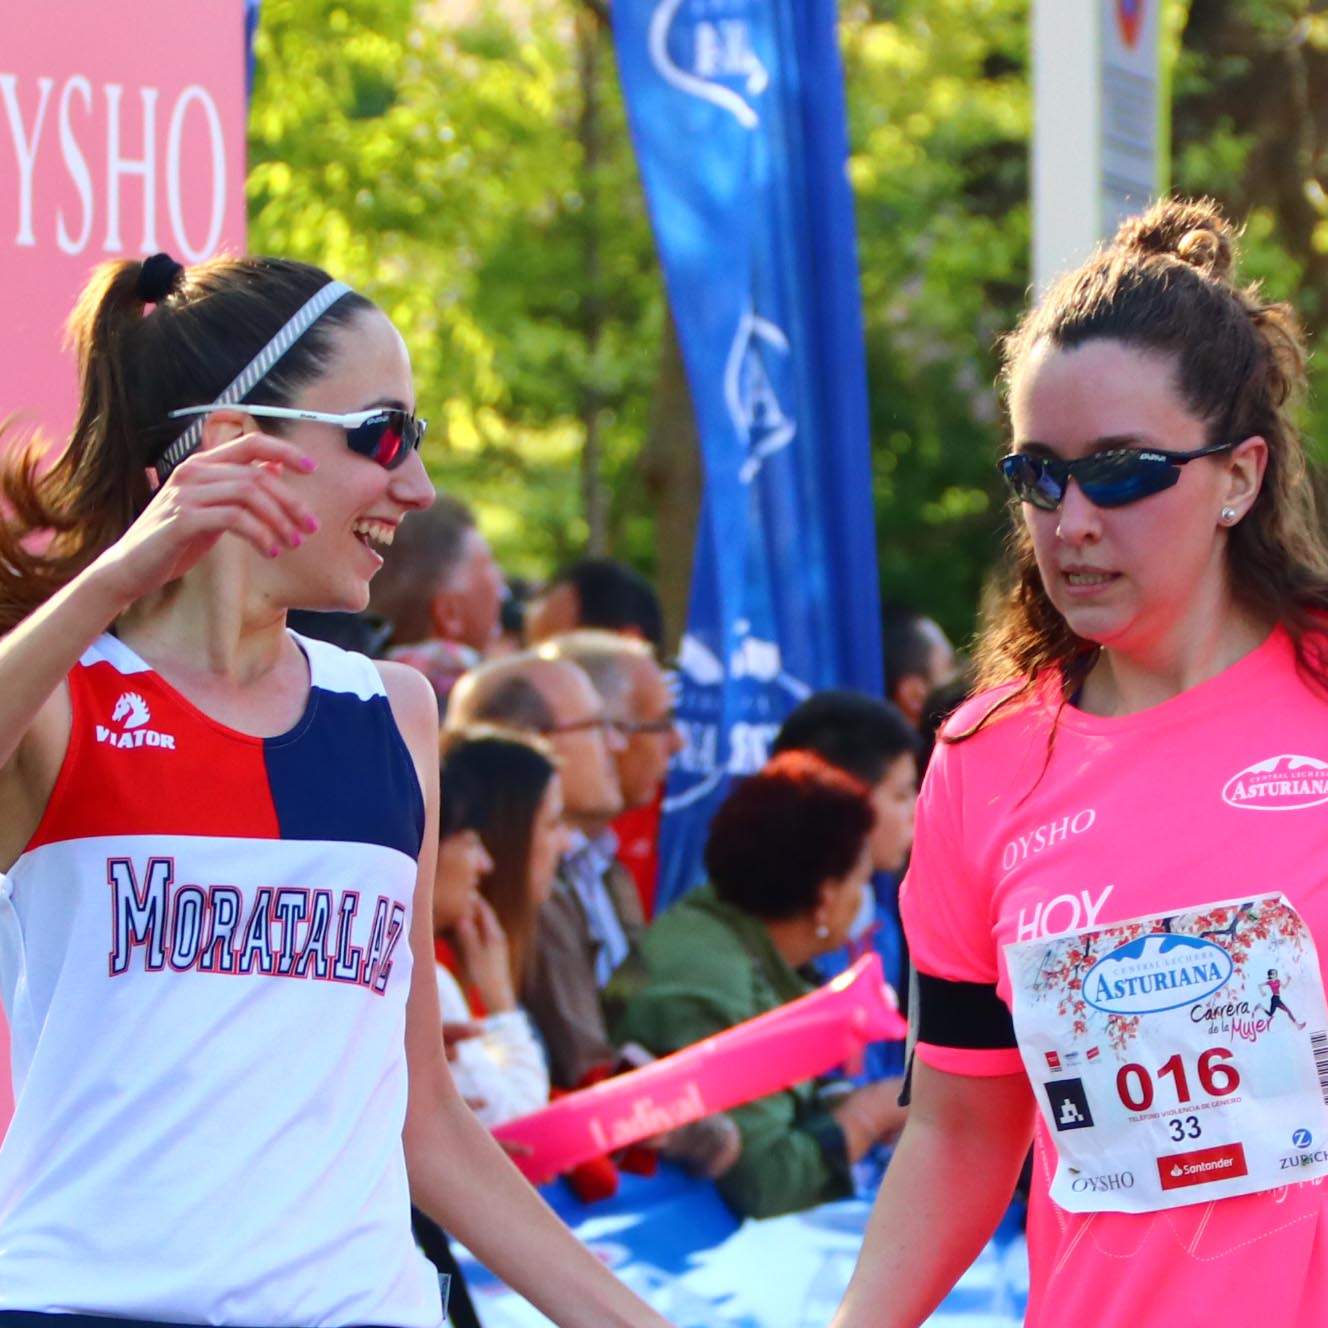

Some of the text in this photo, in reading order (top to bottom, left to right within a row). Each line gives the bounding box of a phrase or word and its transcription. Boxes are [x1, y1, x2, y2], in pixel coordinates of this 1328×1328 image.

[95, 724, 176, 750] VIATOR
[1002, 808, 1096, 871] OYSHO
[1016, 884, 1114, 943] HOY
[1094, 961, 1223, 1003] ASTURIANA
[1190, 1001, 1250, 1023] Carrera
[1230, 1016, 1274, 1042] Mujer
[1115, 1047, 1241, 1112] 016
[1168, 1115, 1203, 1143] 33
[1183, 1157, 1234, 1176] Santander
[1072, 1171, 1134, 1193] OYSHO
